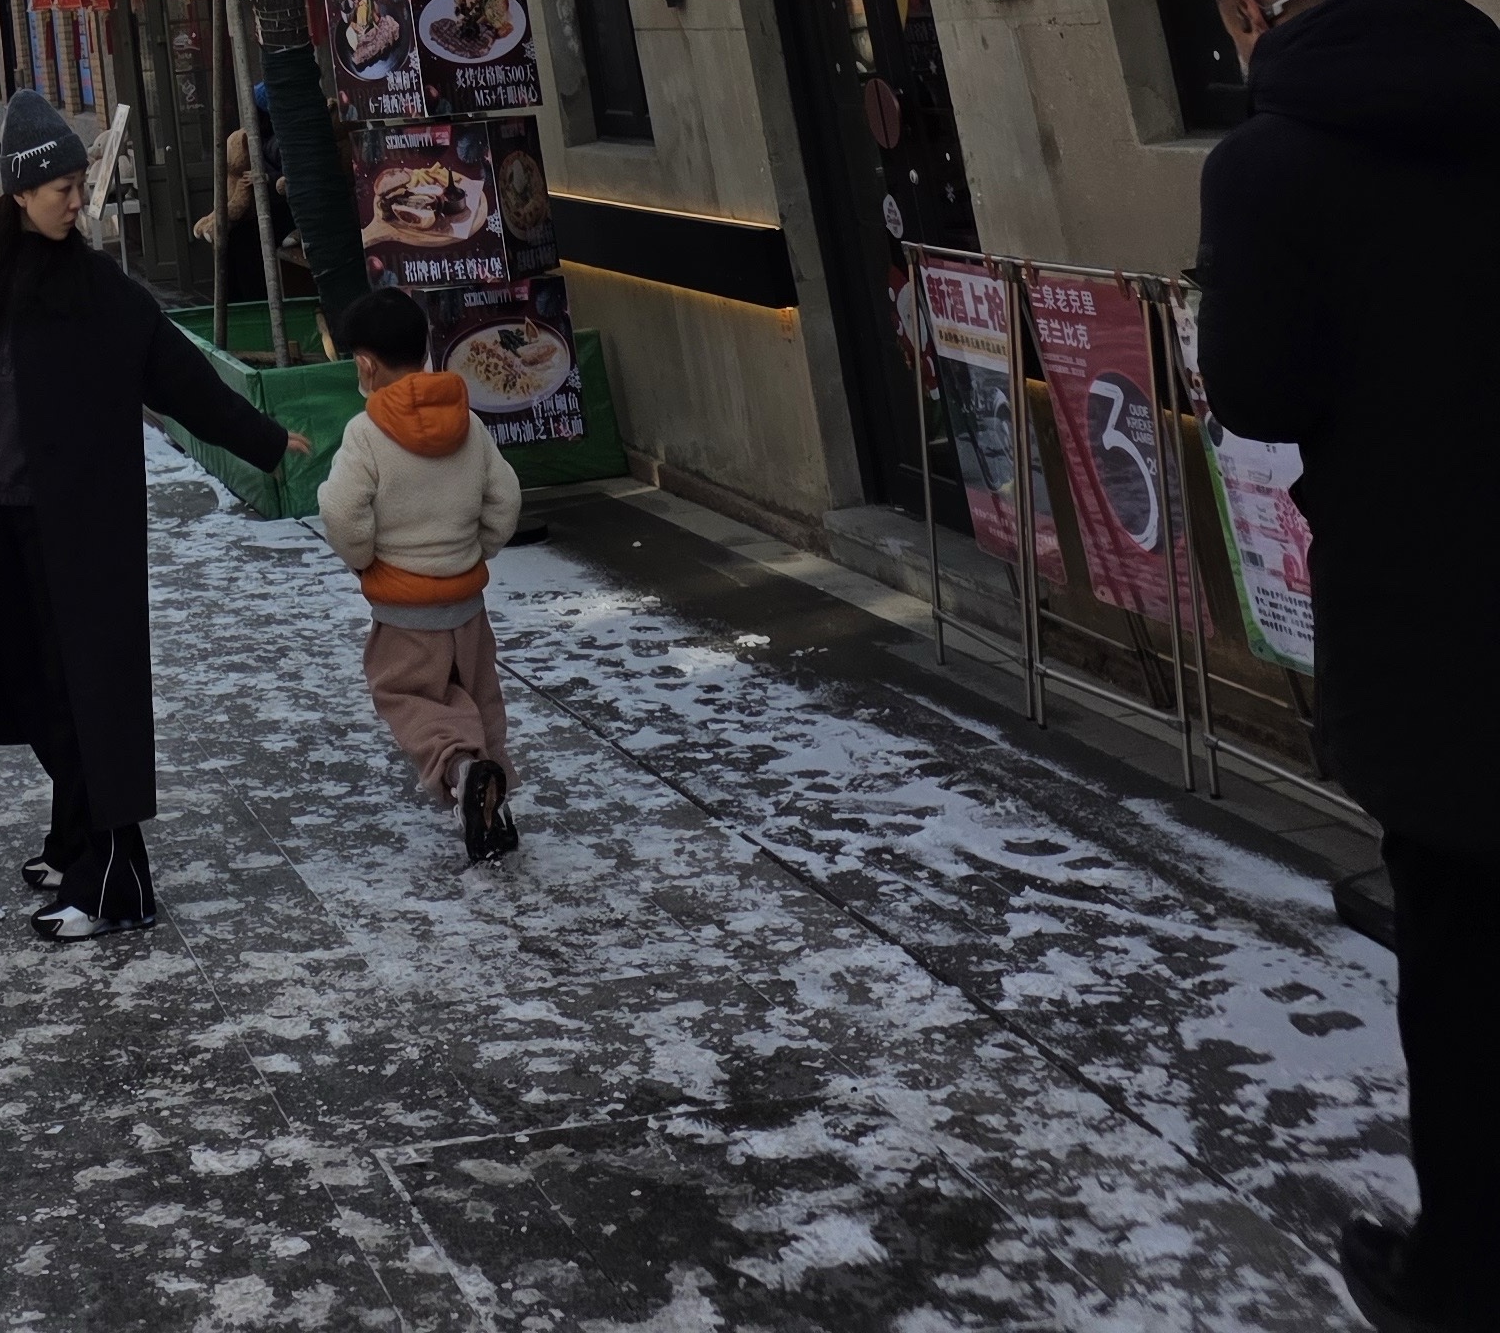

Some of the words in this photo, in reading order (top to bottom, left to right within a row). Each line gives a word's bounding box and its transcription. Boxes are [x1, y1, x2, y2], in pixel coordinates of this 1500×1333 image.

[403, 256, 504, 283] 招牌和牛至尊汉堡
[1036, 317, 1091, 350] 克兰比克
[1129, 403, 1149, 418] OUDE
